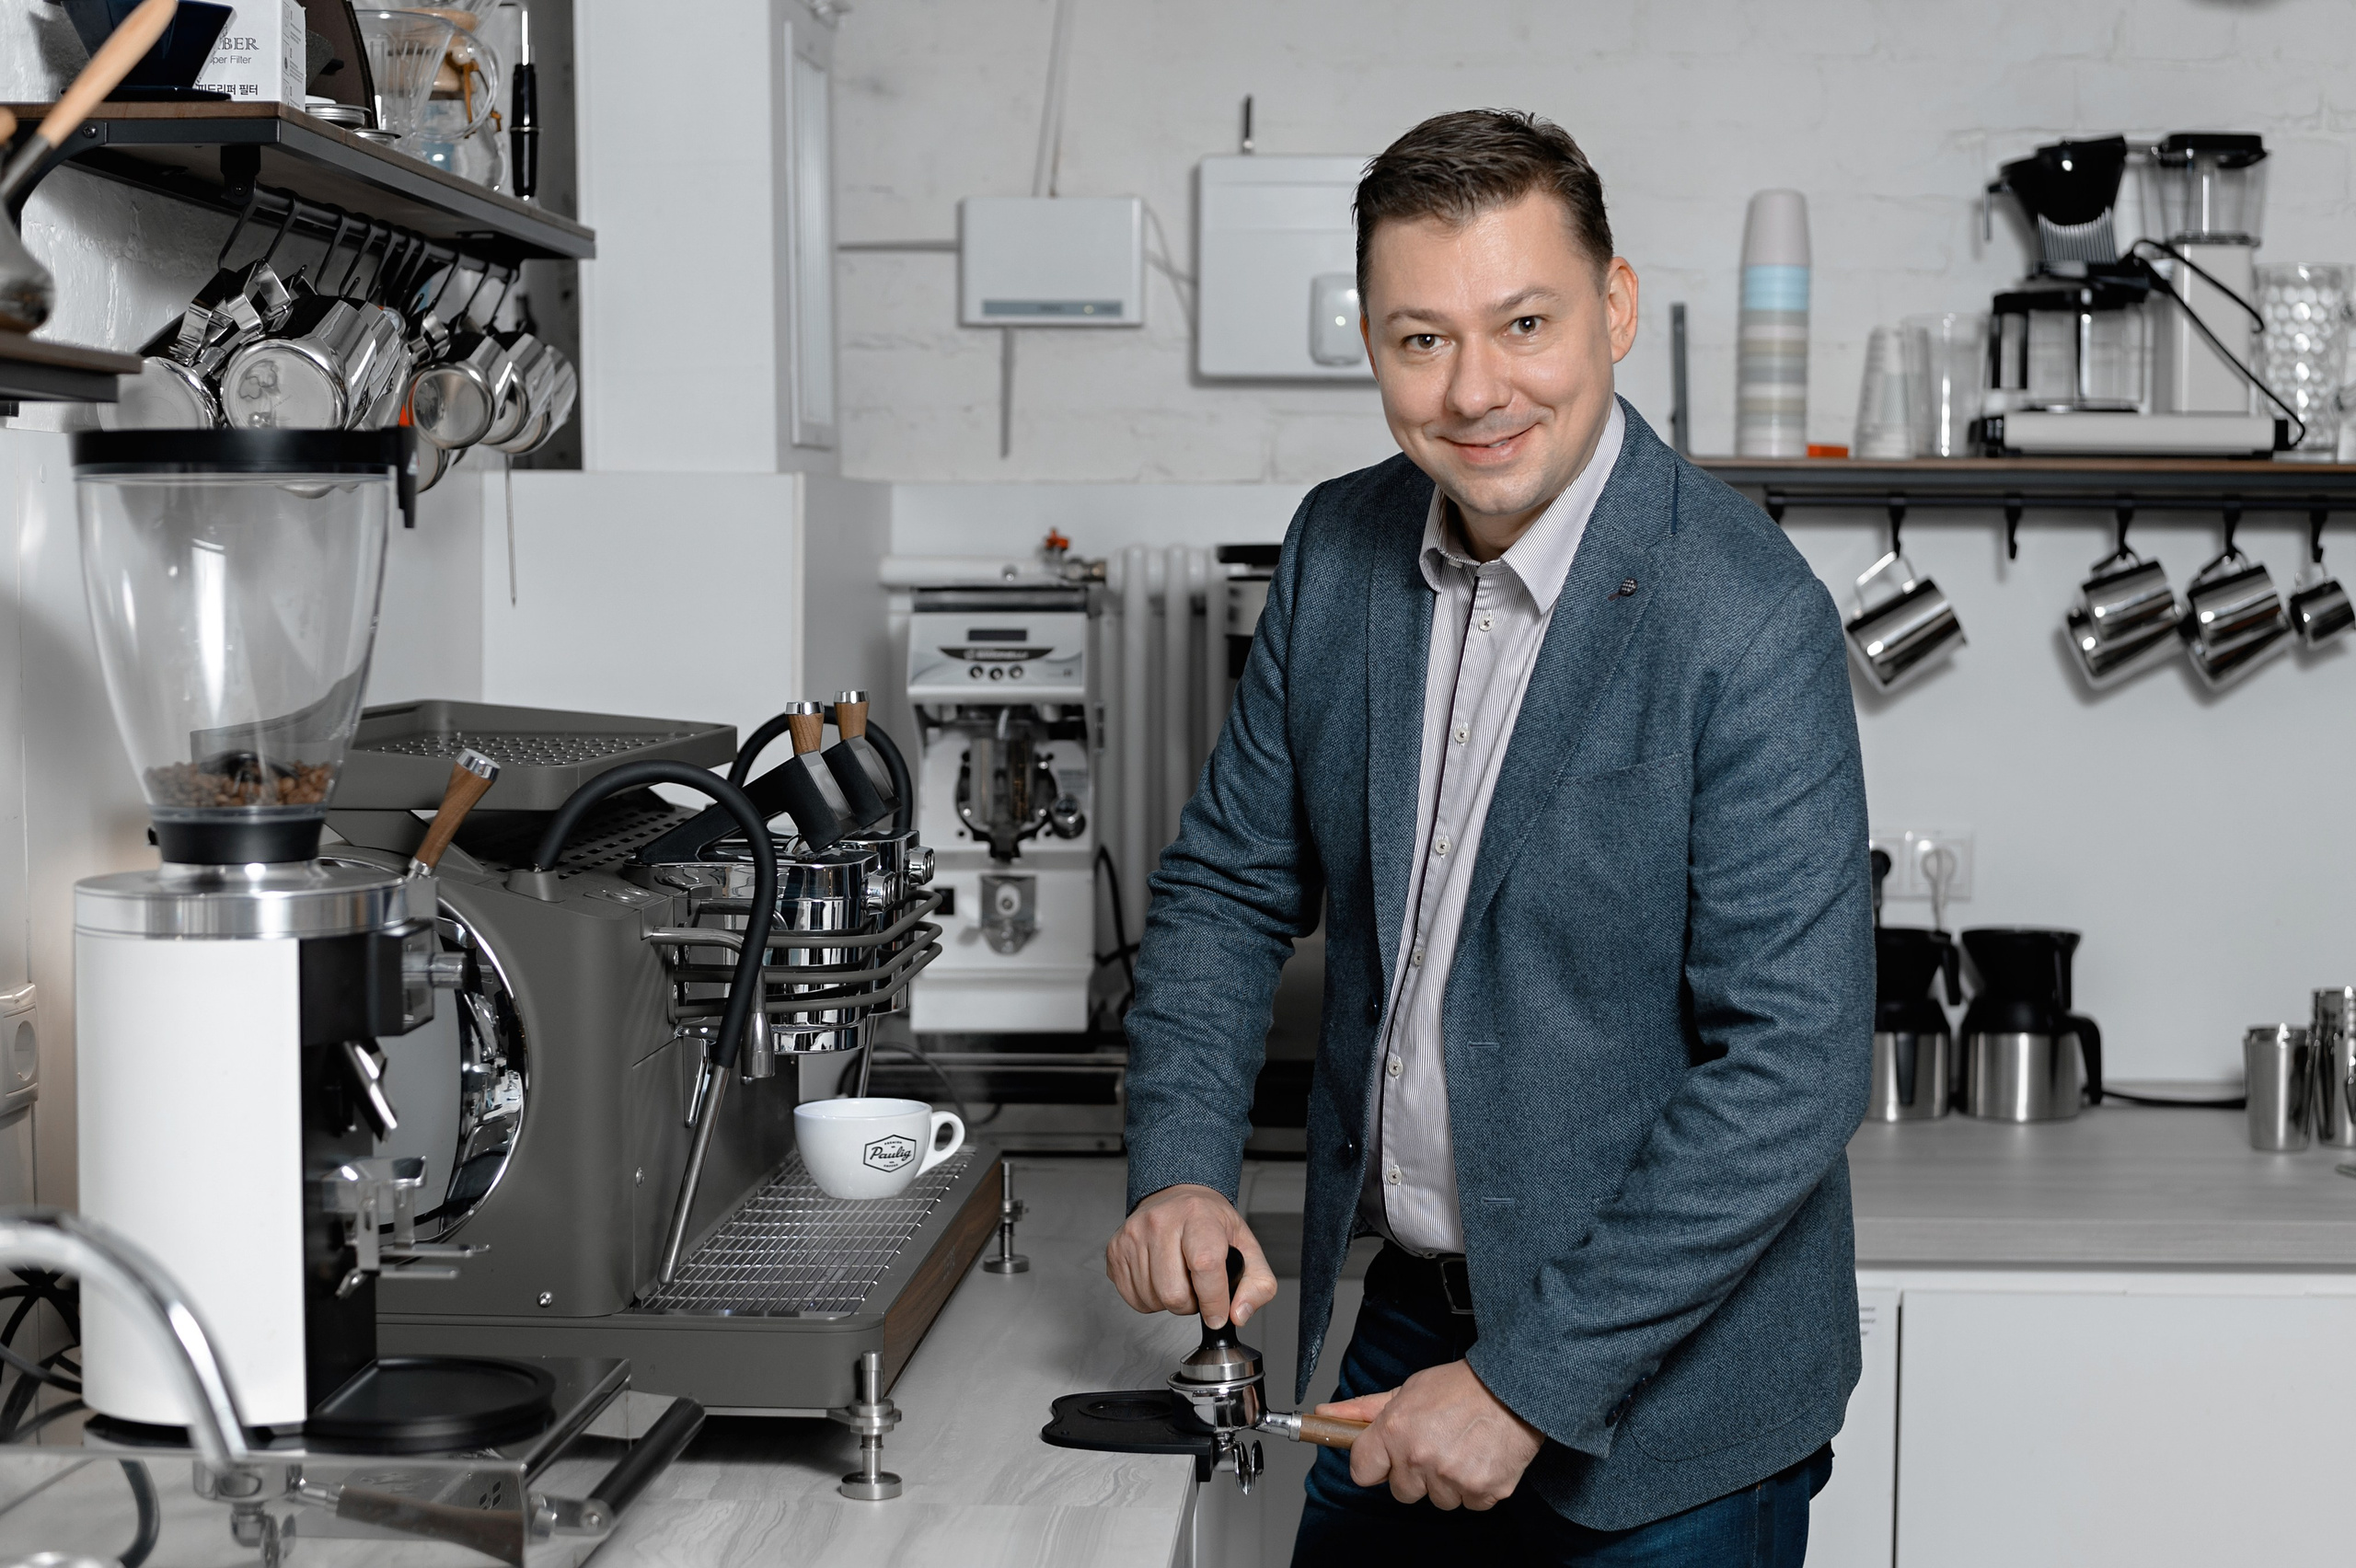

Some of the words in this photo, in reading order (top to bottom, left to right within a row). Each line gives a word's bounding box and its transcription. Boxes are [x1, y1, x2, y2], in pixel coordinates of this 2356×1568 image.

[217, 37, 260, 51] BER
[230, 55, 252, 64] Filter
[238, 84, 259, 96] 필터
[870, 1146, 911, 1161] Paulig
